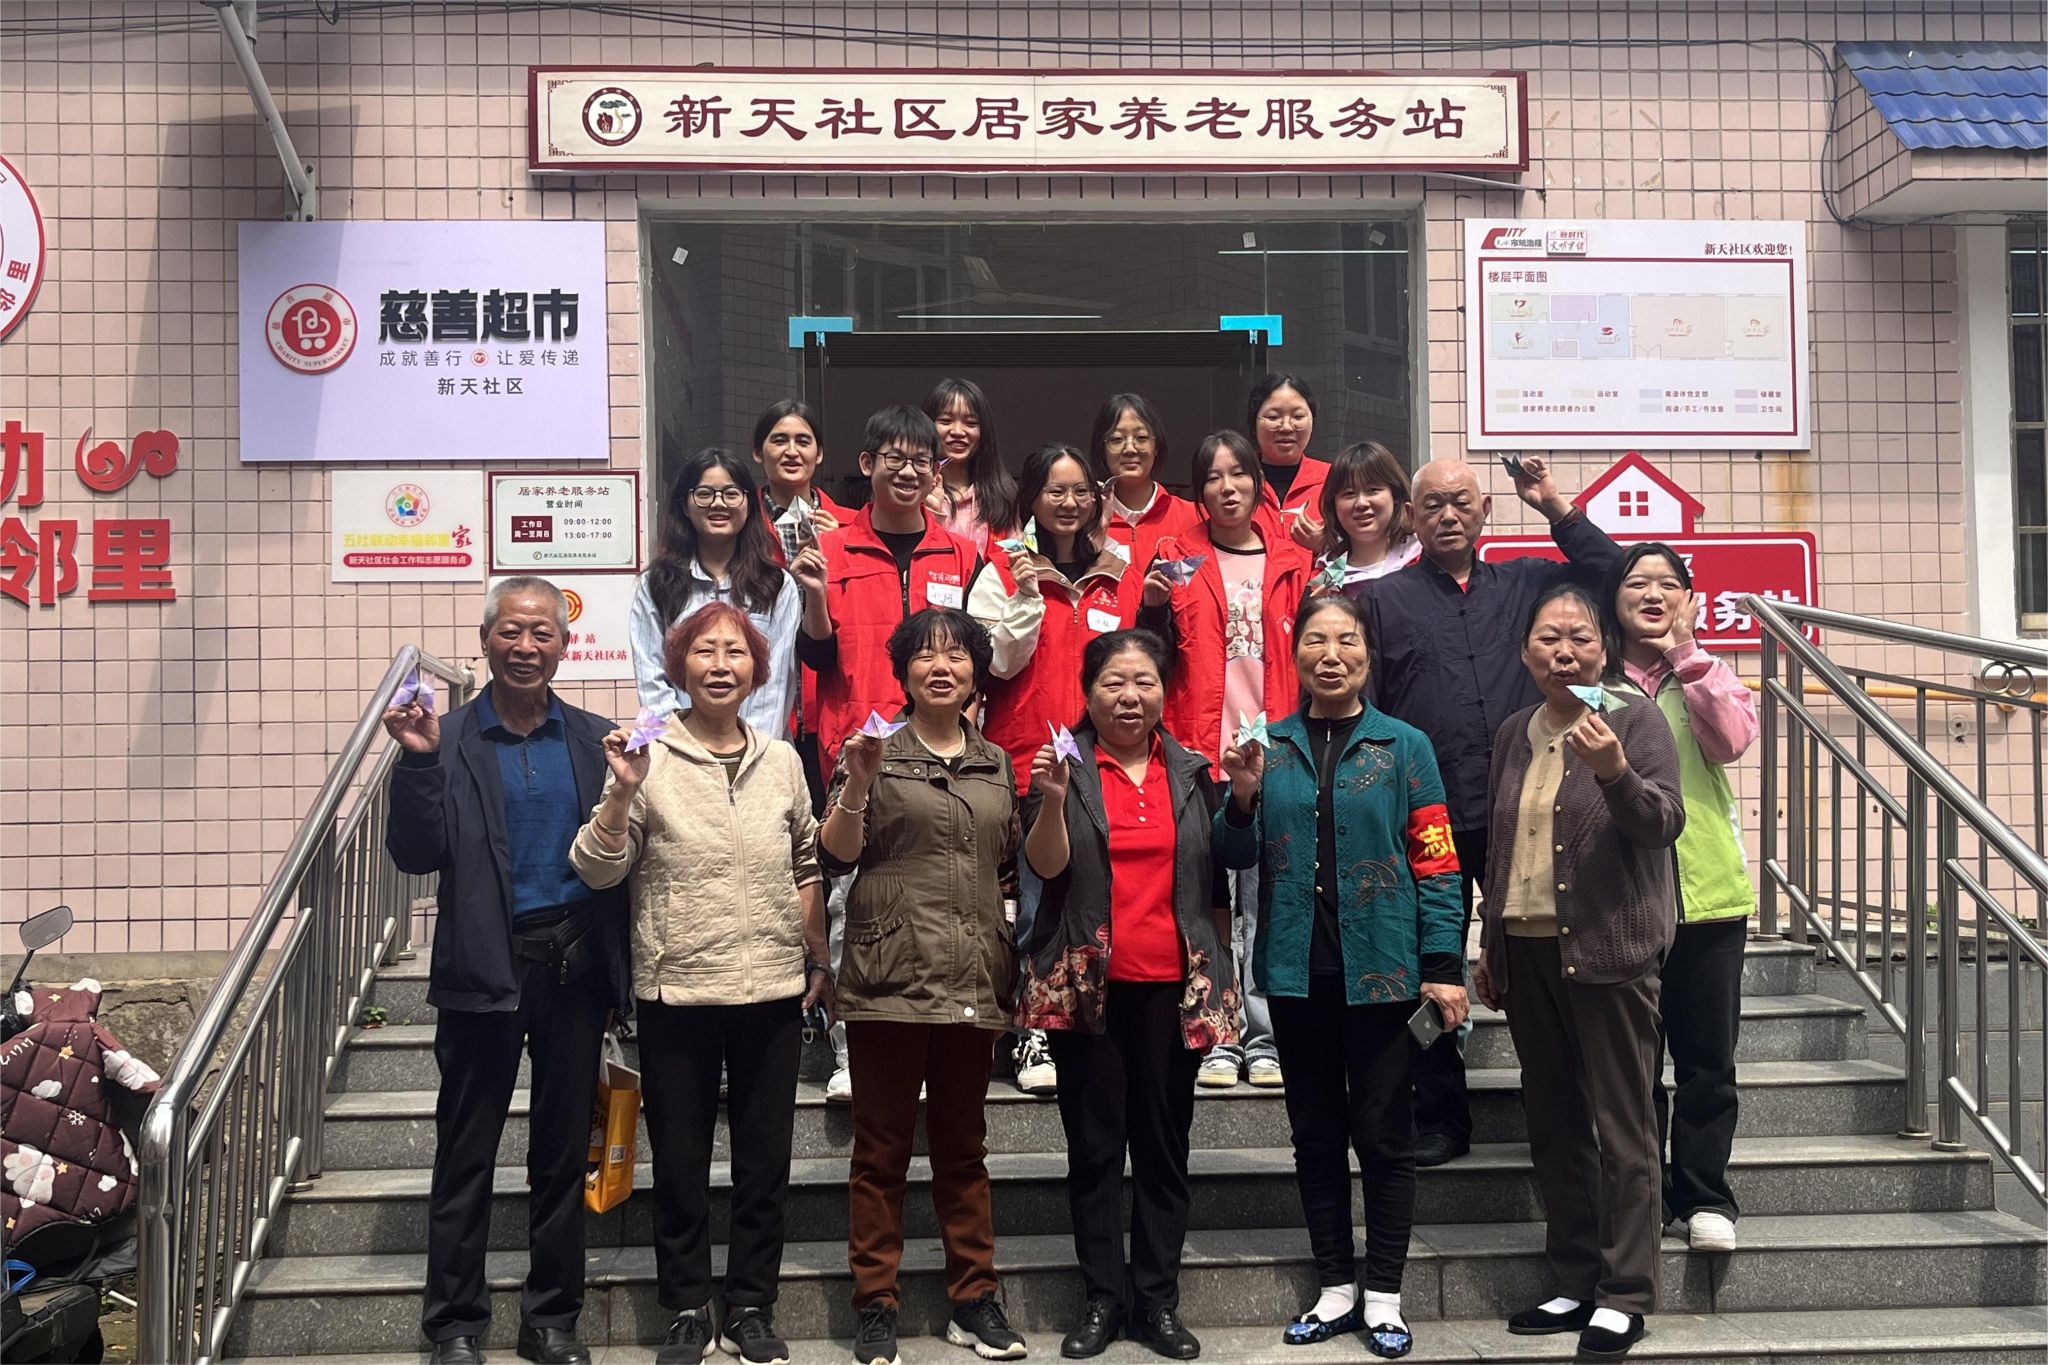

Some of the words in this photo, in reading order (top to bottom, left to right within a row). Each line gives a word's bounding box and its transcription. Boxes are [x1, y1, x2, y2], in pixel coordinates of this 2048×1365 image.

[663, 94, 1467, 141] 新天社区居家养老服务站
[1704, 243, 1793, 255] 新天社区欢迎您!
[1488, 272, 1548, 283] 楼层平面图
[378, 288, 580, 343] 慈善超市
[379, 350, 463, 367] 成就善行
[497, 350, 580, 367] 让爱传递
[437, 377, 524, 395] 新天社区
[518, 486, 611, 497] 居家养老服务站
[546, 499, 583, 509] 营业时间
[521, 520, 543, 528] 工作日
[563, 518, 612, 526] 09:00-12:00
[514, 530, 550, 539] 周一至周日
[563, 532, 612, 540] 13:00-17:00
